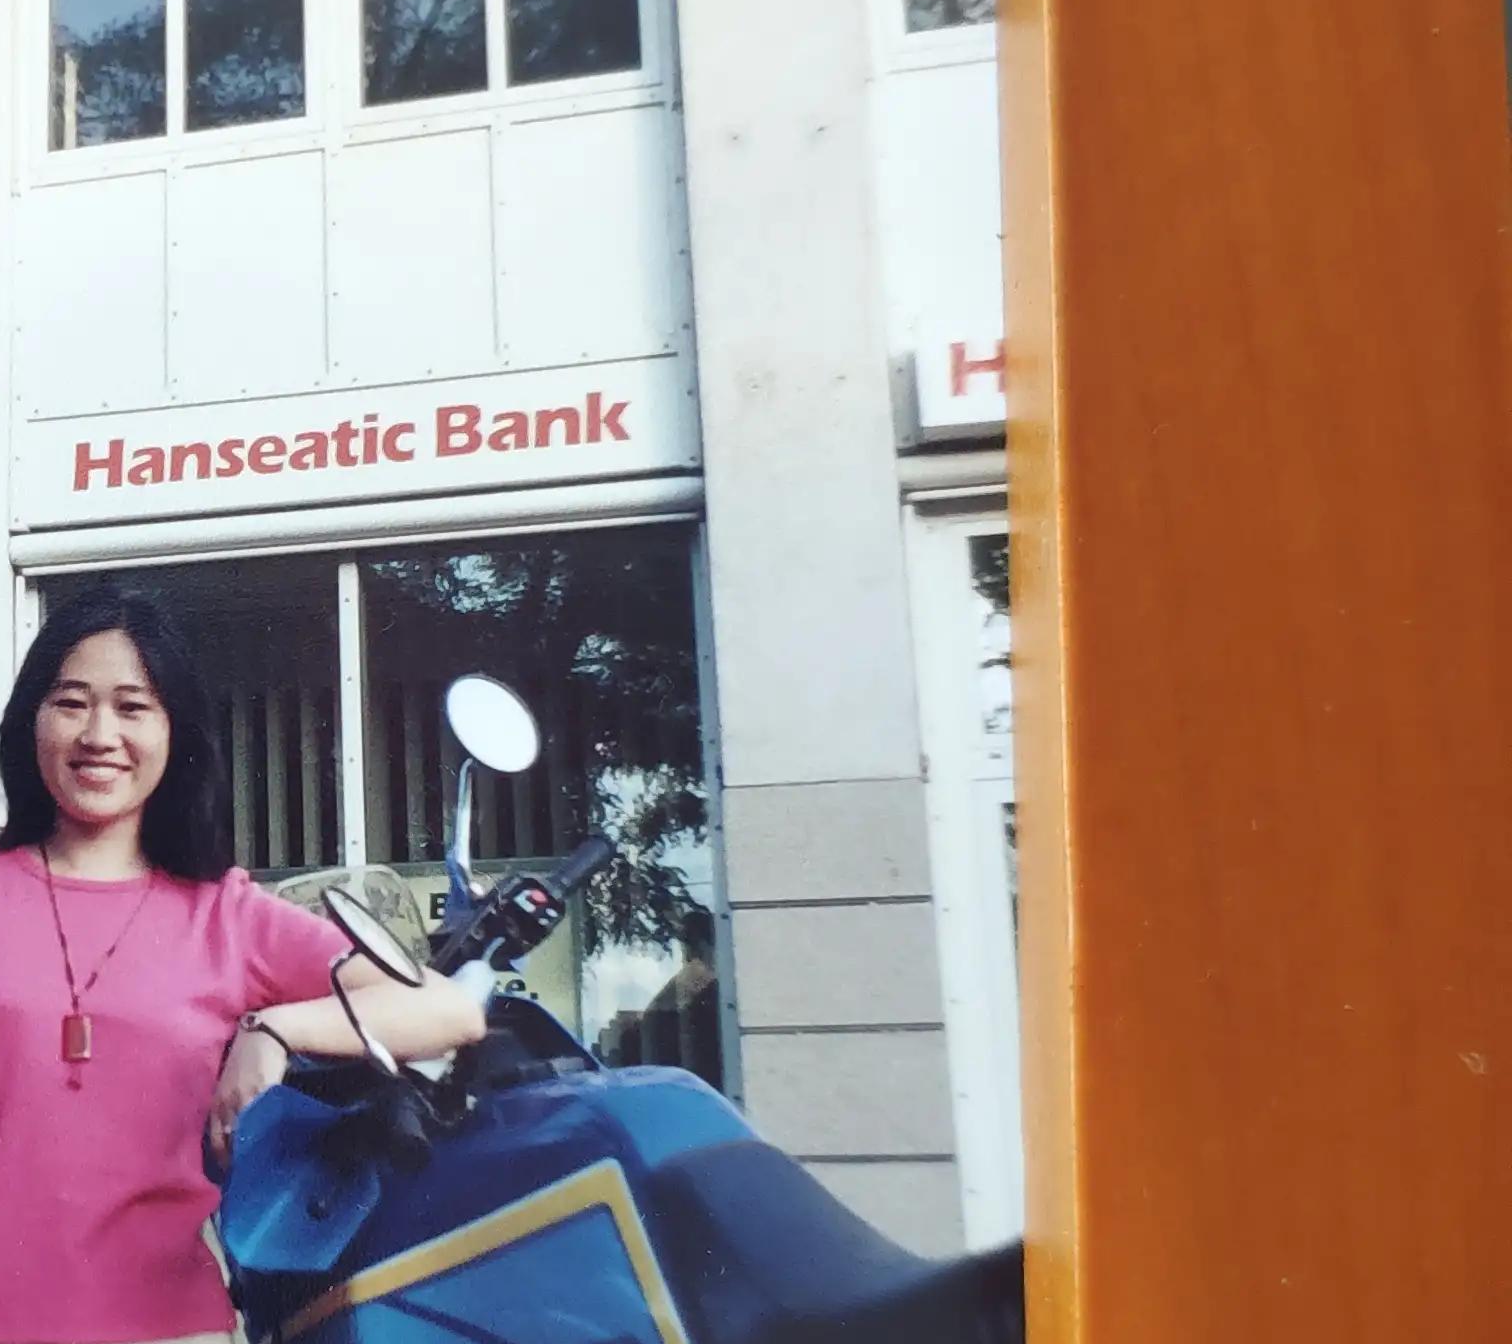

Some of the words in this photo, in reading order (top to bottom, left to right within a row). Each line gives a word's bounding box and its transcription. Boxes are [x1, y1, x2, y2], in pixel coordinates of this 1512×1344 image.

[949, 340, 1006, 397] H
[72, 413, 417, 491] Hanseatic
[435, 391, 631, 458] Bank
